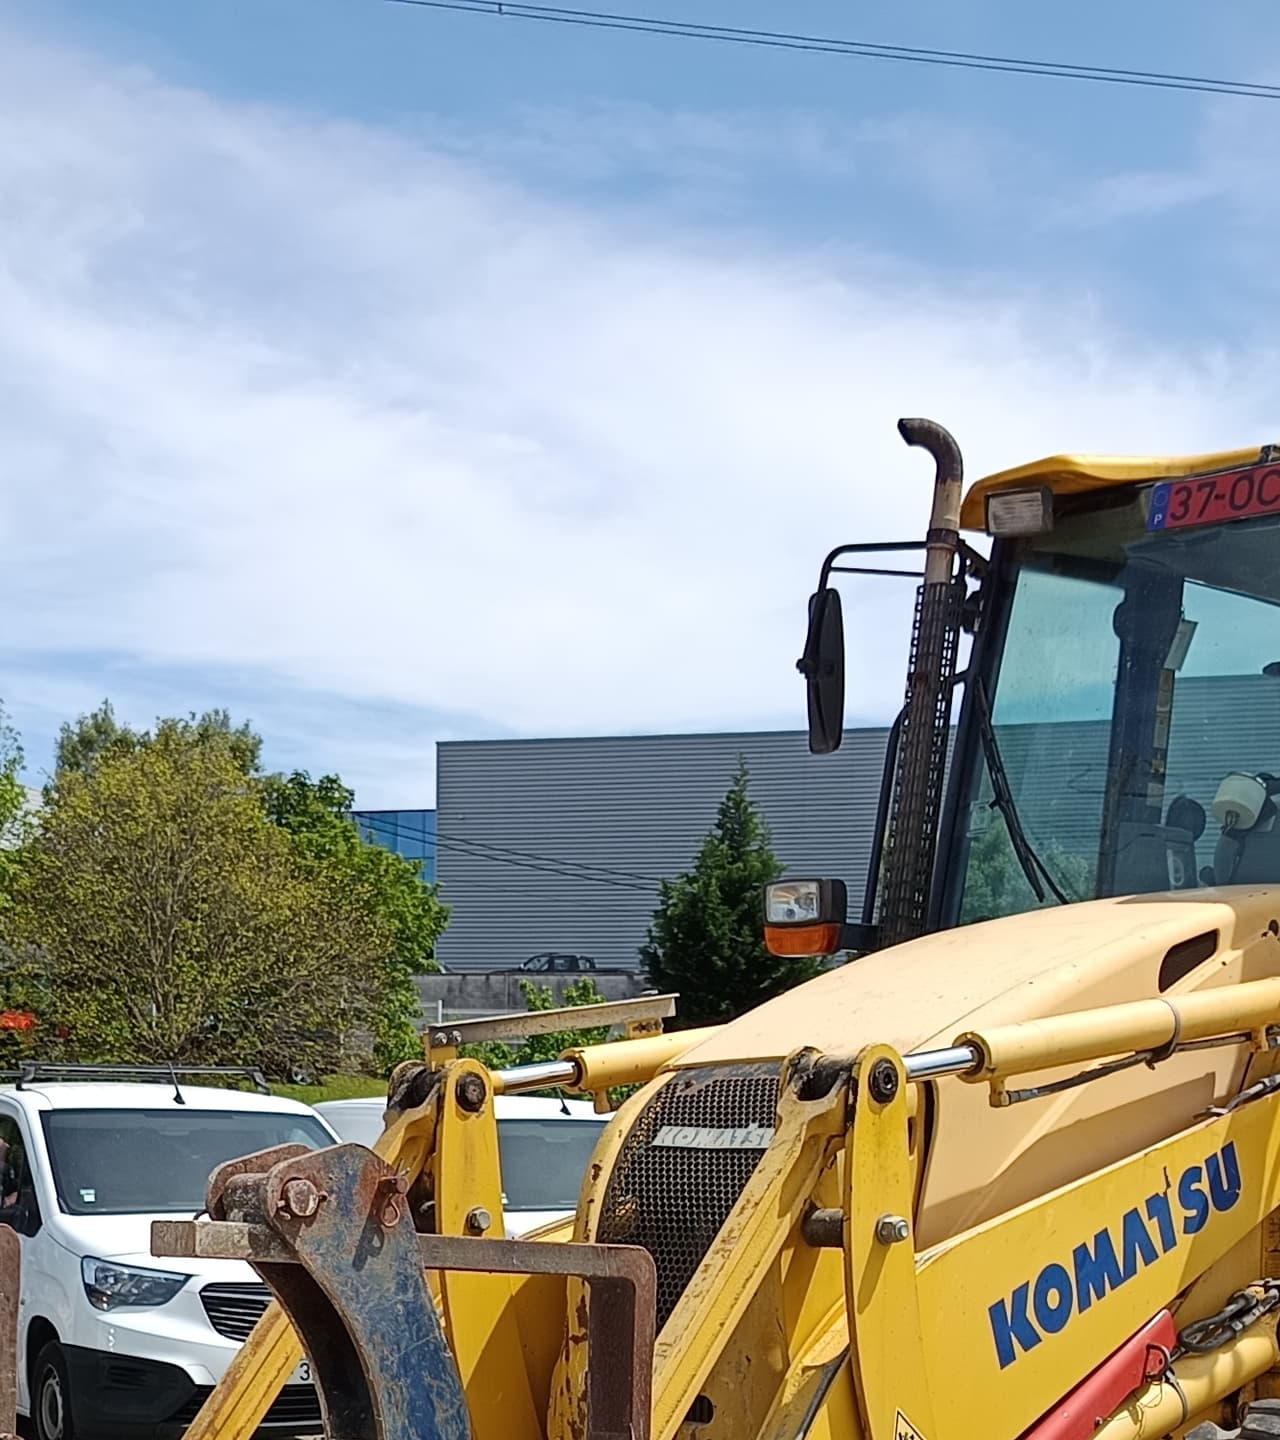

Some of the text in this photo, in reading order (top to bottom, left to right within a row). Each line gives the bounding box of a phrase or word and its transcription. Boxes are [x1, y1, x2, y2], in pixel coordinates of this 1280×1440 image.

[1153, 513, 1162, 525] P
[652, 1122, 776, 1149] KOMATS
[988, 1140, 1242, 1370] KOMATSU
